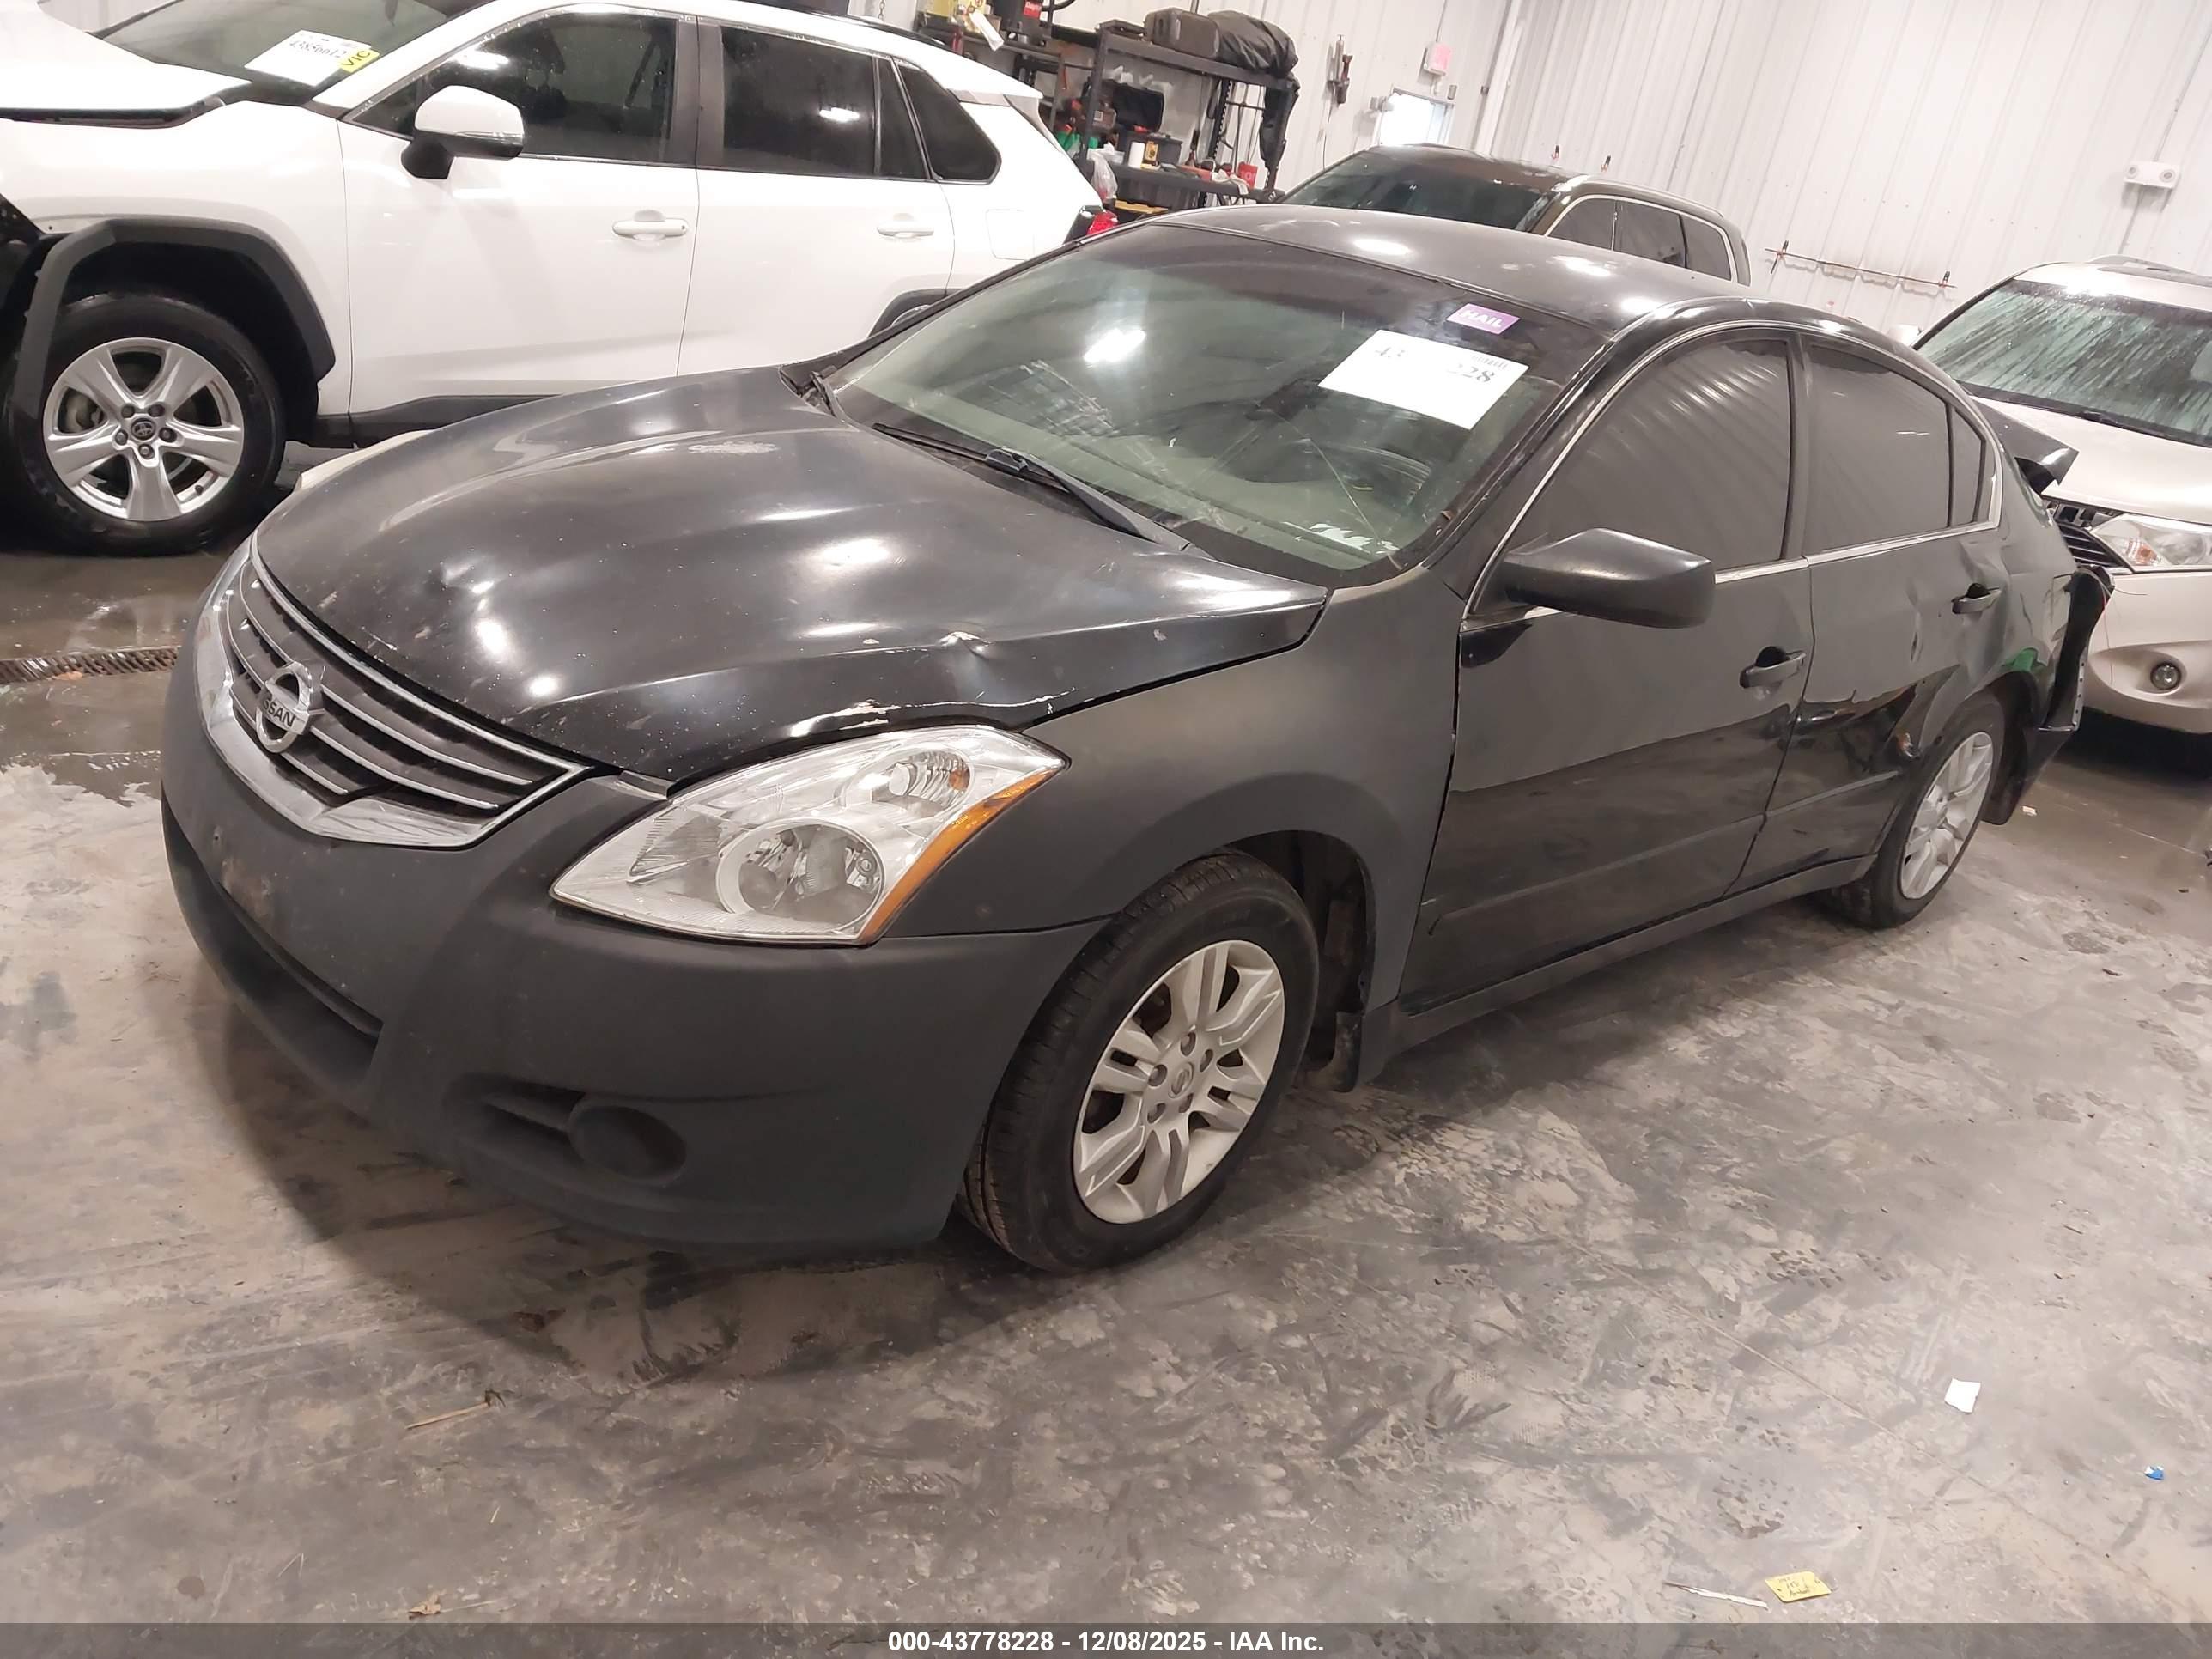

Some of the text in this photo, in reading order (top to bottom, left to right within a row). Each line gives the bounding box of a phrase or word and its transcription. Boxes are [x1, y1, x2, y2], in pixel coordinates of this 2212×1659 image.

[340, 51, 371, 66] VIC
[1459, 310, 1502, 328] HAIL
[262, 697, 296, 727] SSAN
